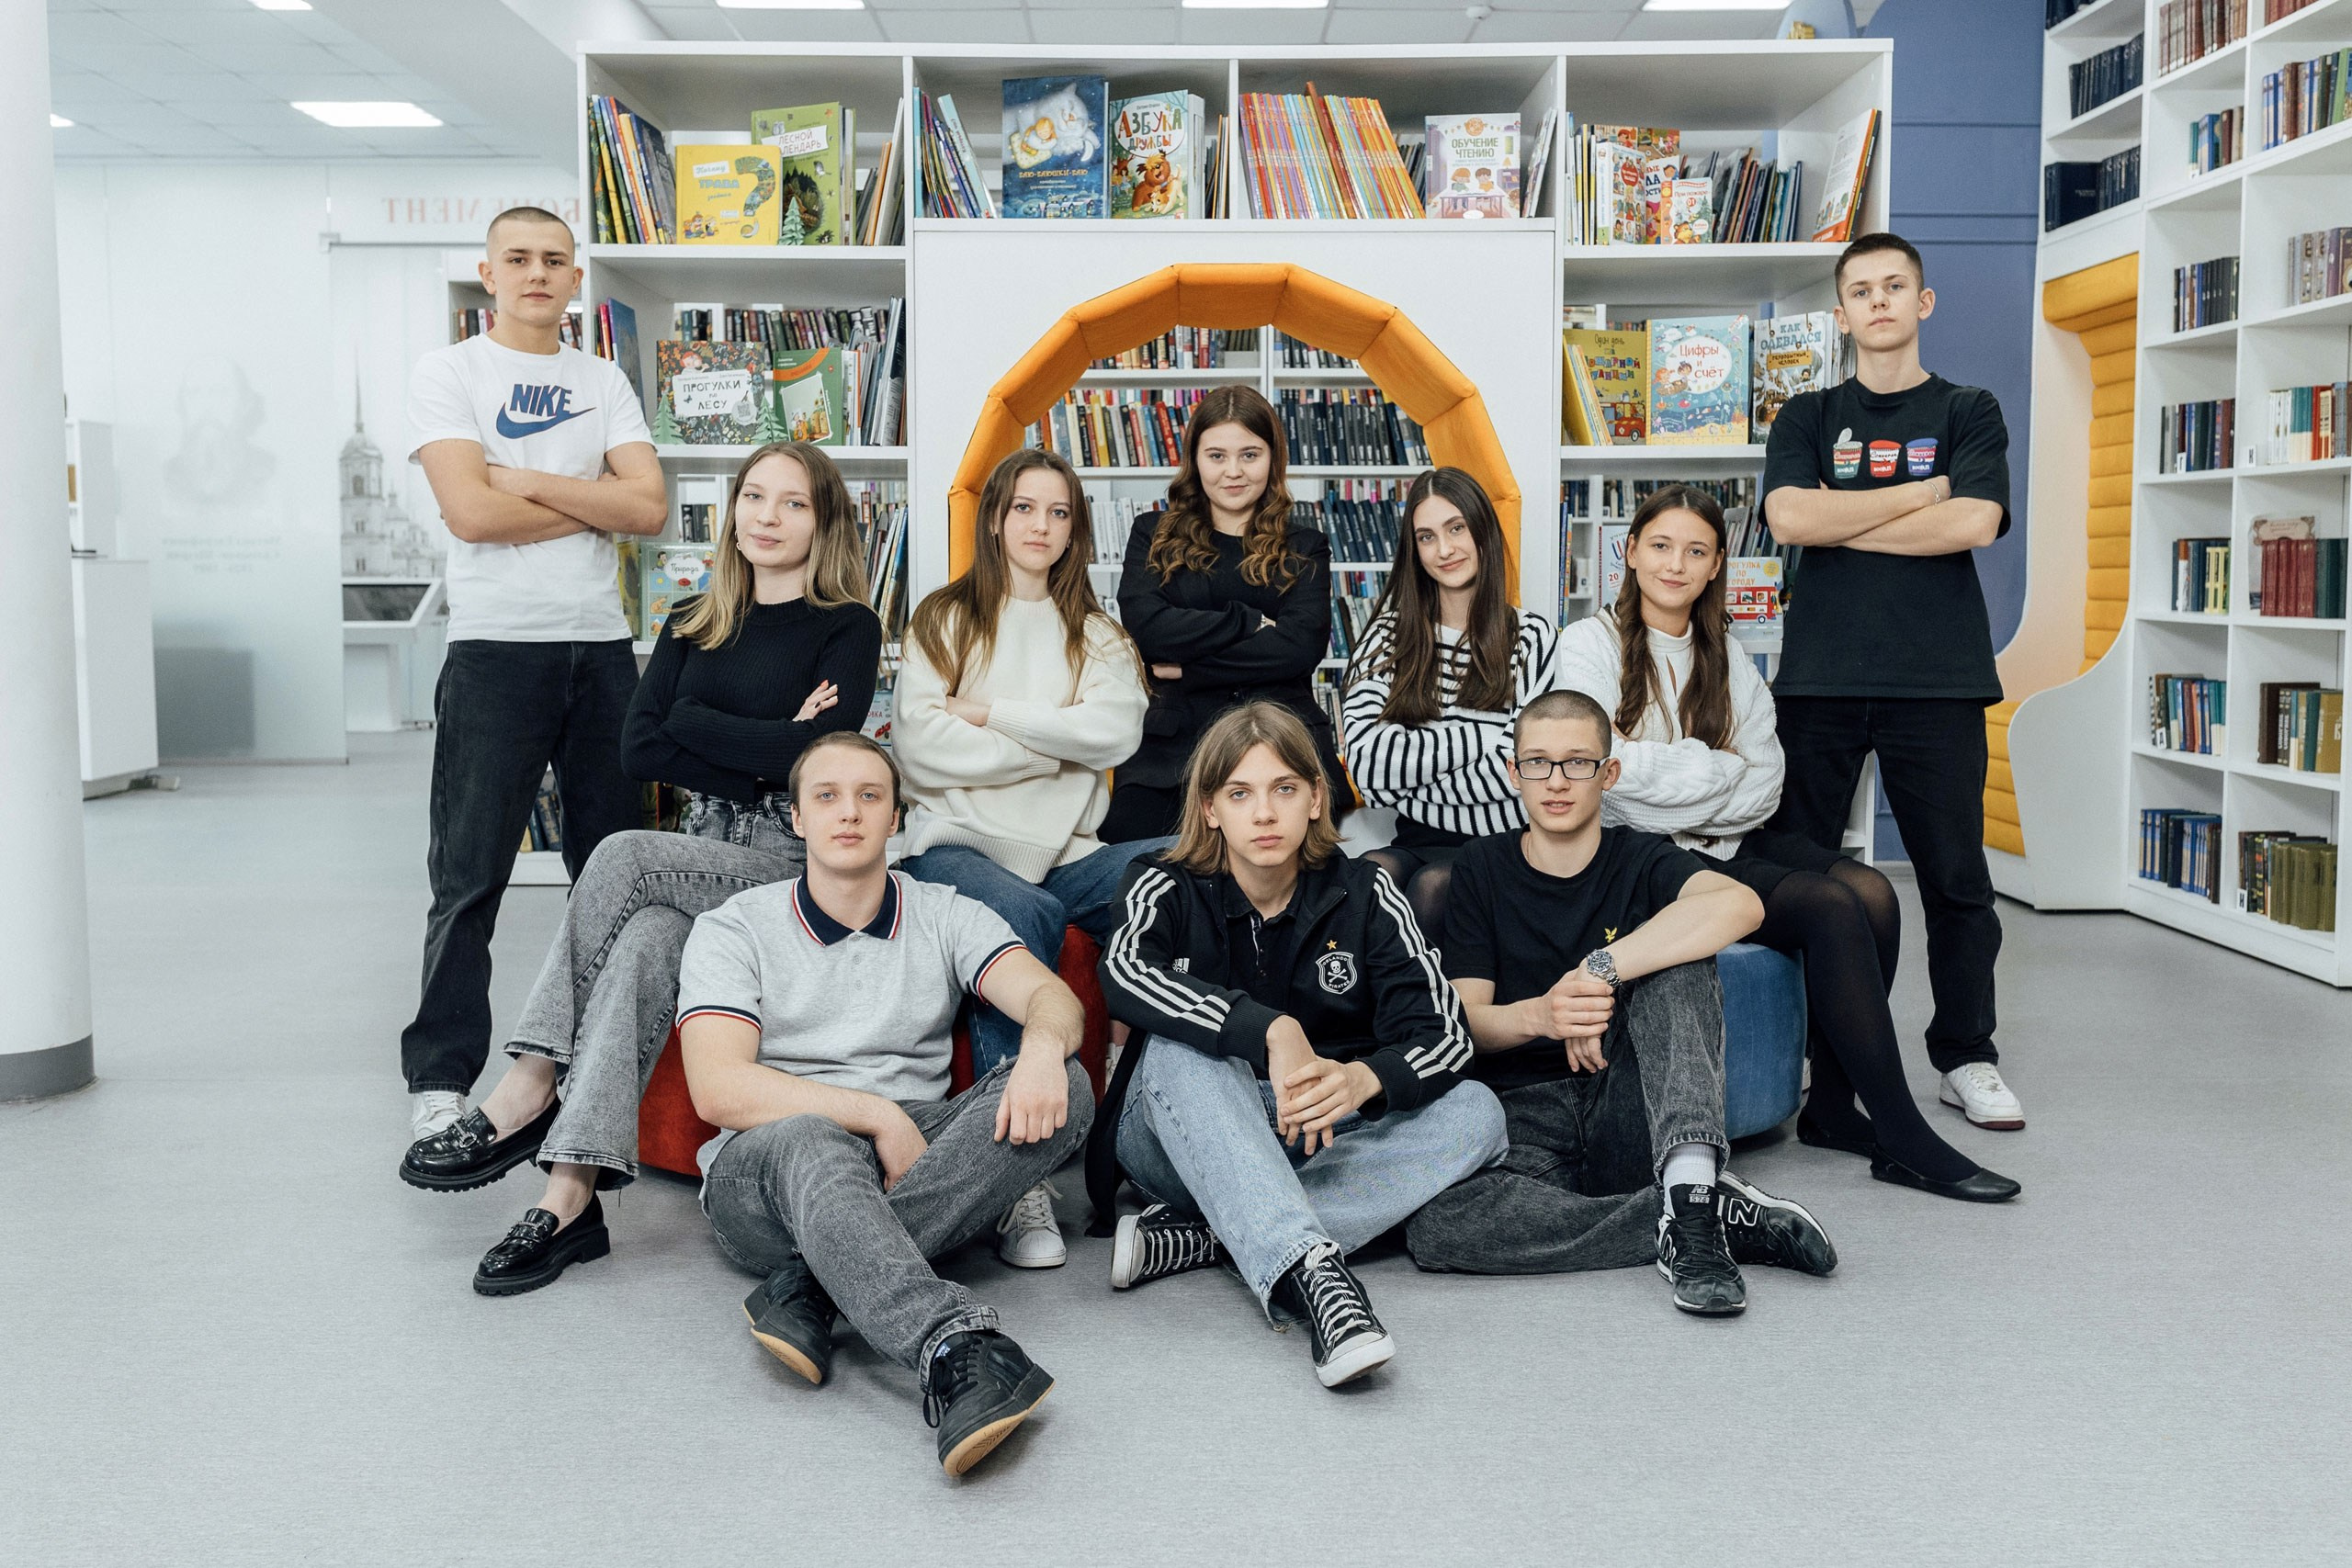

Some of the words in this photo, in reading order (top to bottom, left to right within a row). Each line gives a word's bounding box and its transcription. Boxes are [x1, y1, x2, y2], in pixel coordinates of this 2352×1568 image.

[1117, 108, 1182, 139] АЗБУКА
[779, 129, 813, 145] ЛЕСНОЙ
[1127, 134, 1171, 151] ДРУЖБЫ
[1452, 138, 1498, 149] ОБУЧЕНИЕ
[1455, 148, 1495, 159] ЧТЕНИЮ
[1780, 322, 1801, 333] КАК
[1760, 331, 1822, 350] ОДЕВАЛСЯ
[1679, 344, 1719, 358] Цифры
[1694, 367, 1724, 378] счёт
[683, 380, 741, 393] ПРОГУЛКИ
[510, 383, 572, 417] NIKE
[698, 400, 727, 411] ЛЕСУ
[671, 563, 699, 574] Природа
[1609, 573, 1619, 581] 20
[1323, 956, 1348, 965] ORLANDO
[1727, 1197, 1760, 1227] N
